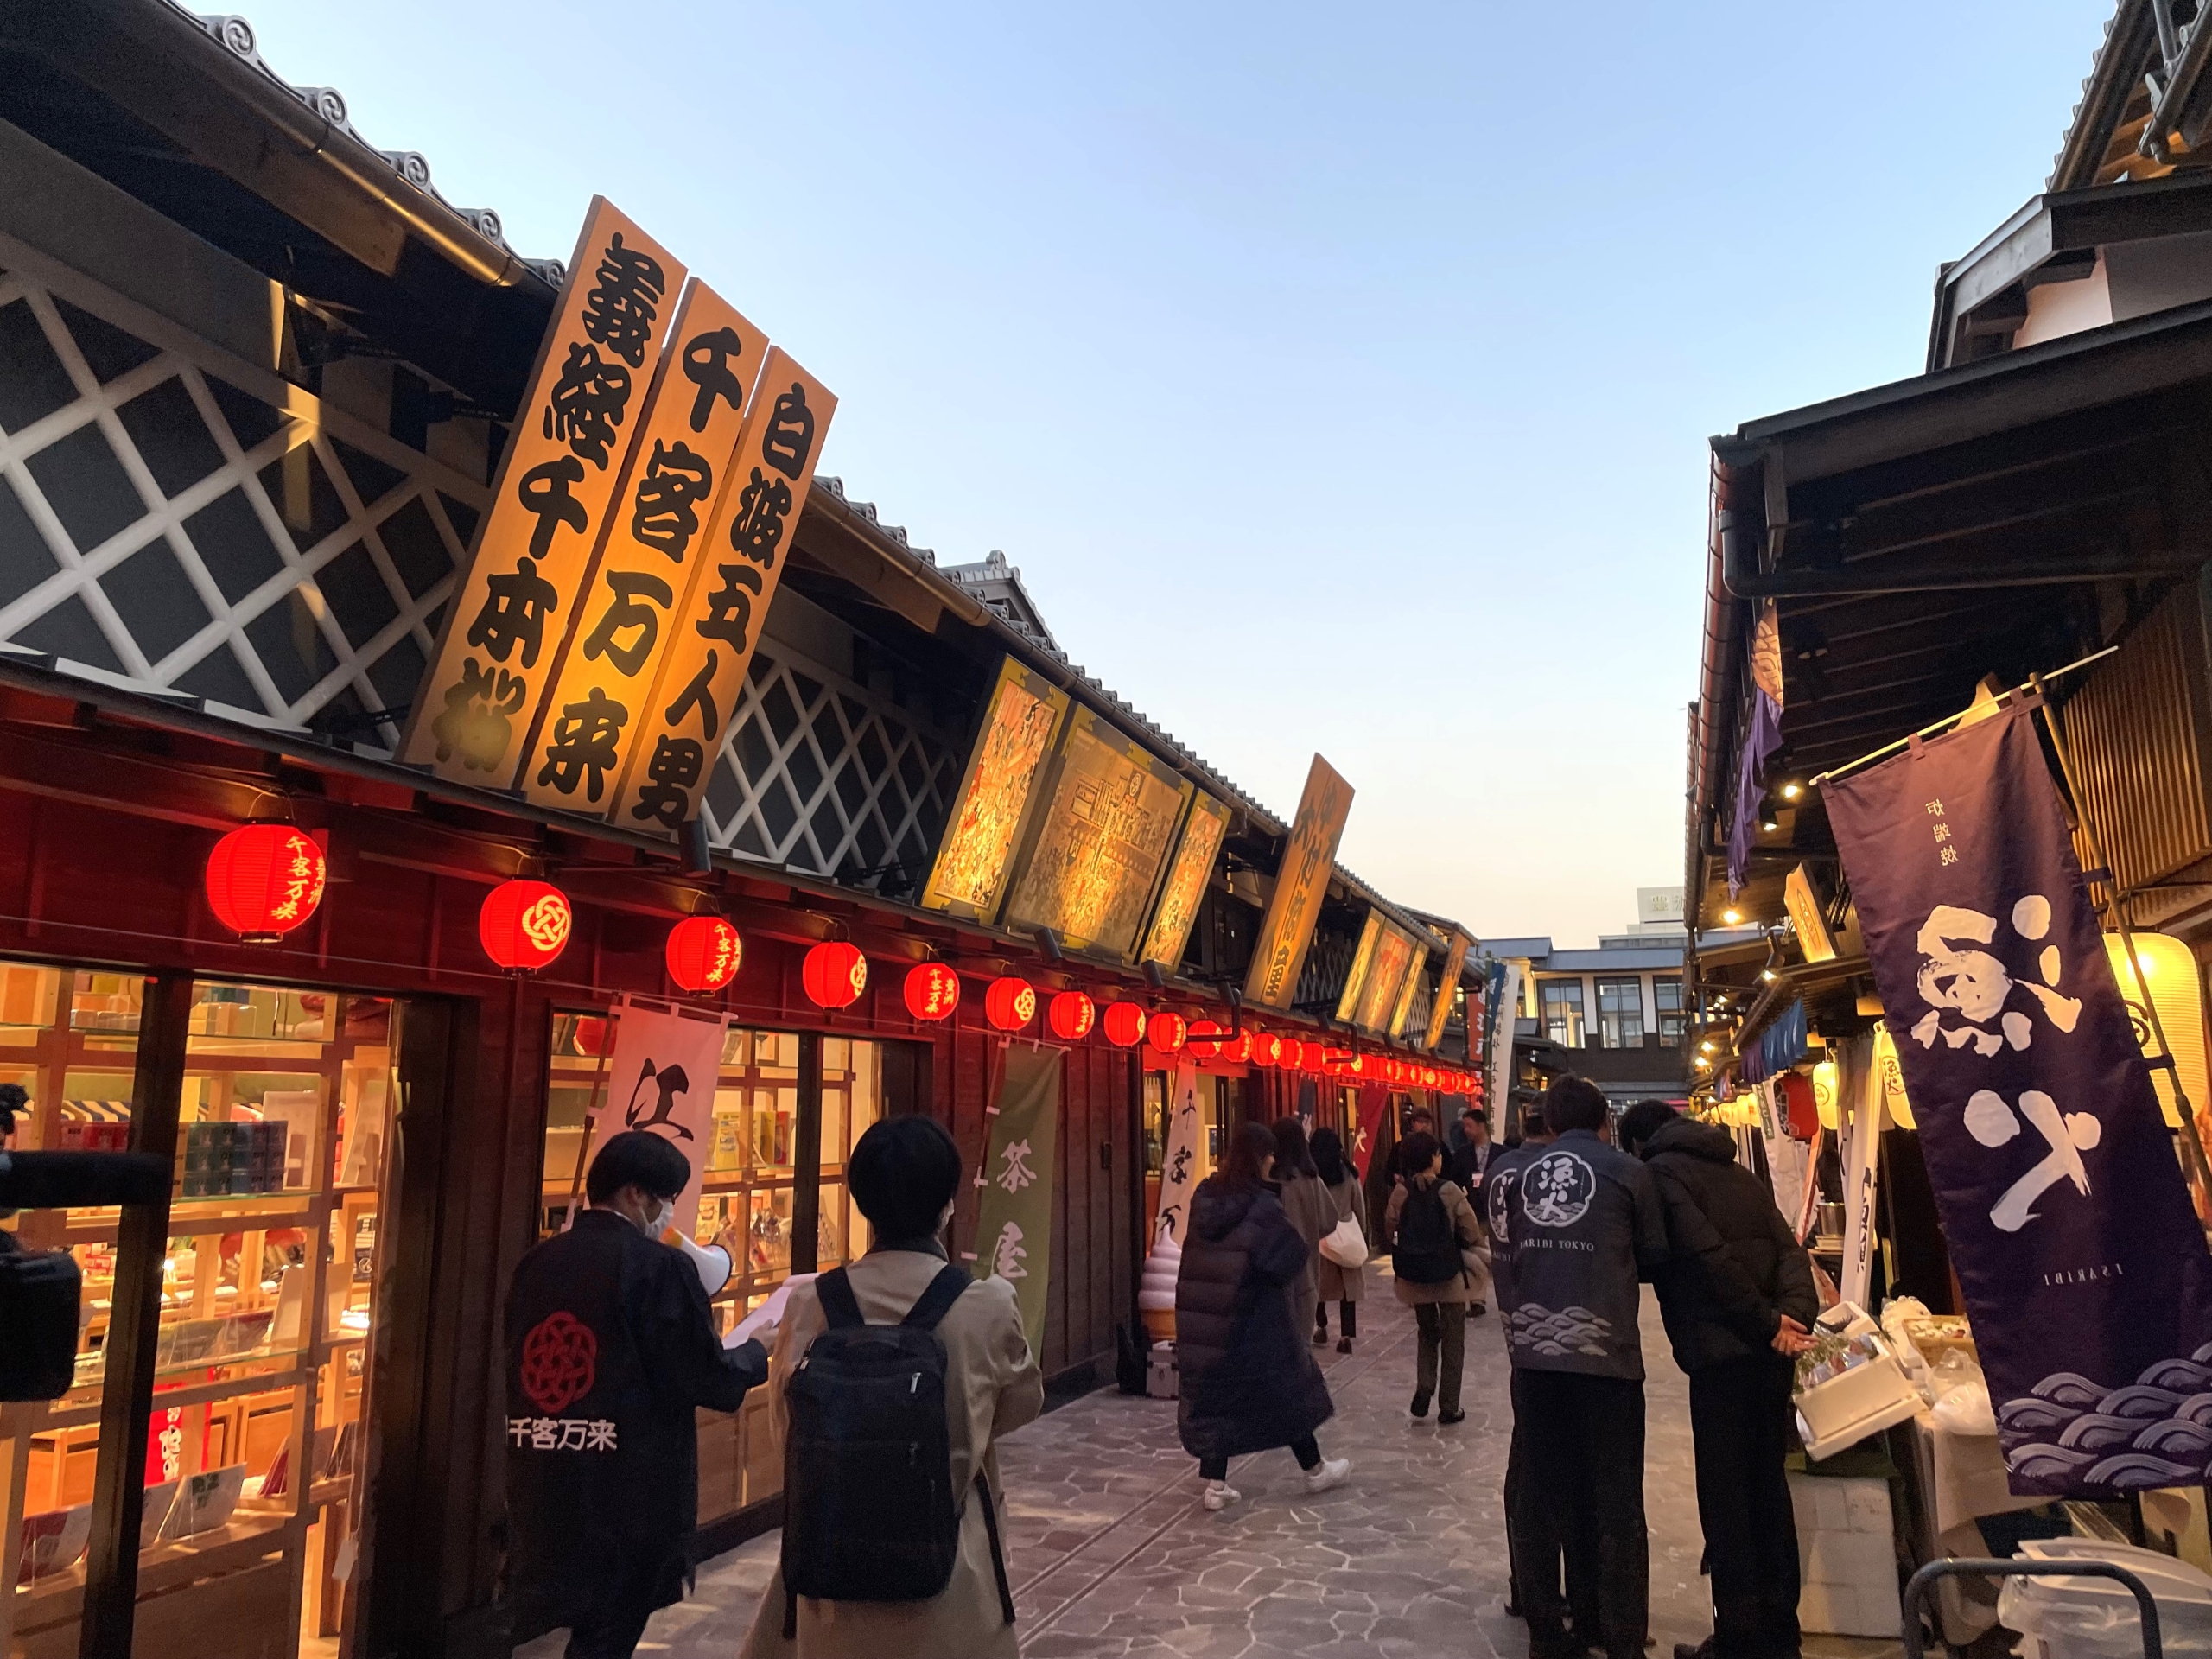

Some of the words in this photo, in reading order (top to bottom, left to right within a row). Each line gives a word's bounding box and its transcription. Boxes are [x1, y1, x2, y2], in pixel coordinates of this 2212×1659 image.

[537, 327, 743, 803] 千客万来
[632, 382, 815, 827] 白波五人男
[1558, 1239, 1594, 1252] TOKYO
[508, 1416, 618, 1452] 千客万来
